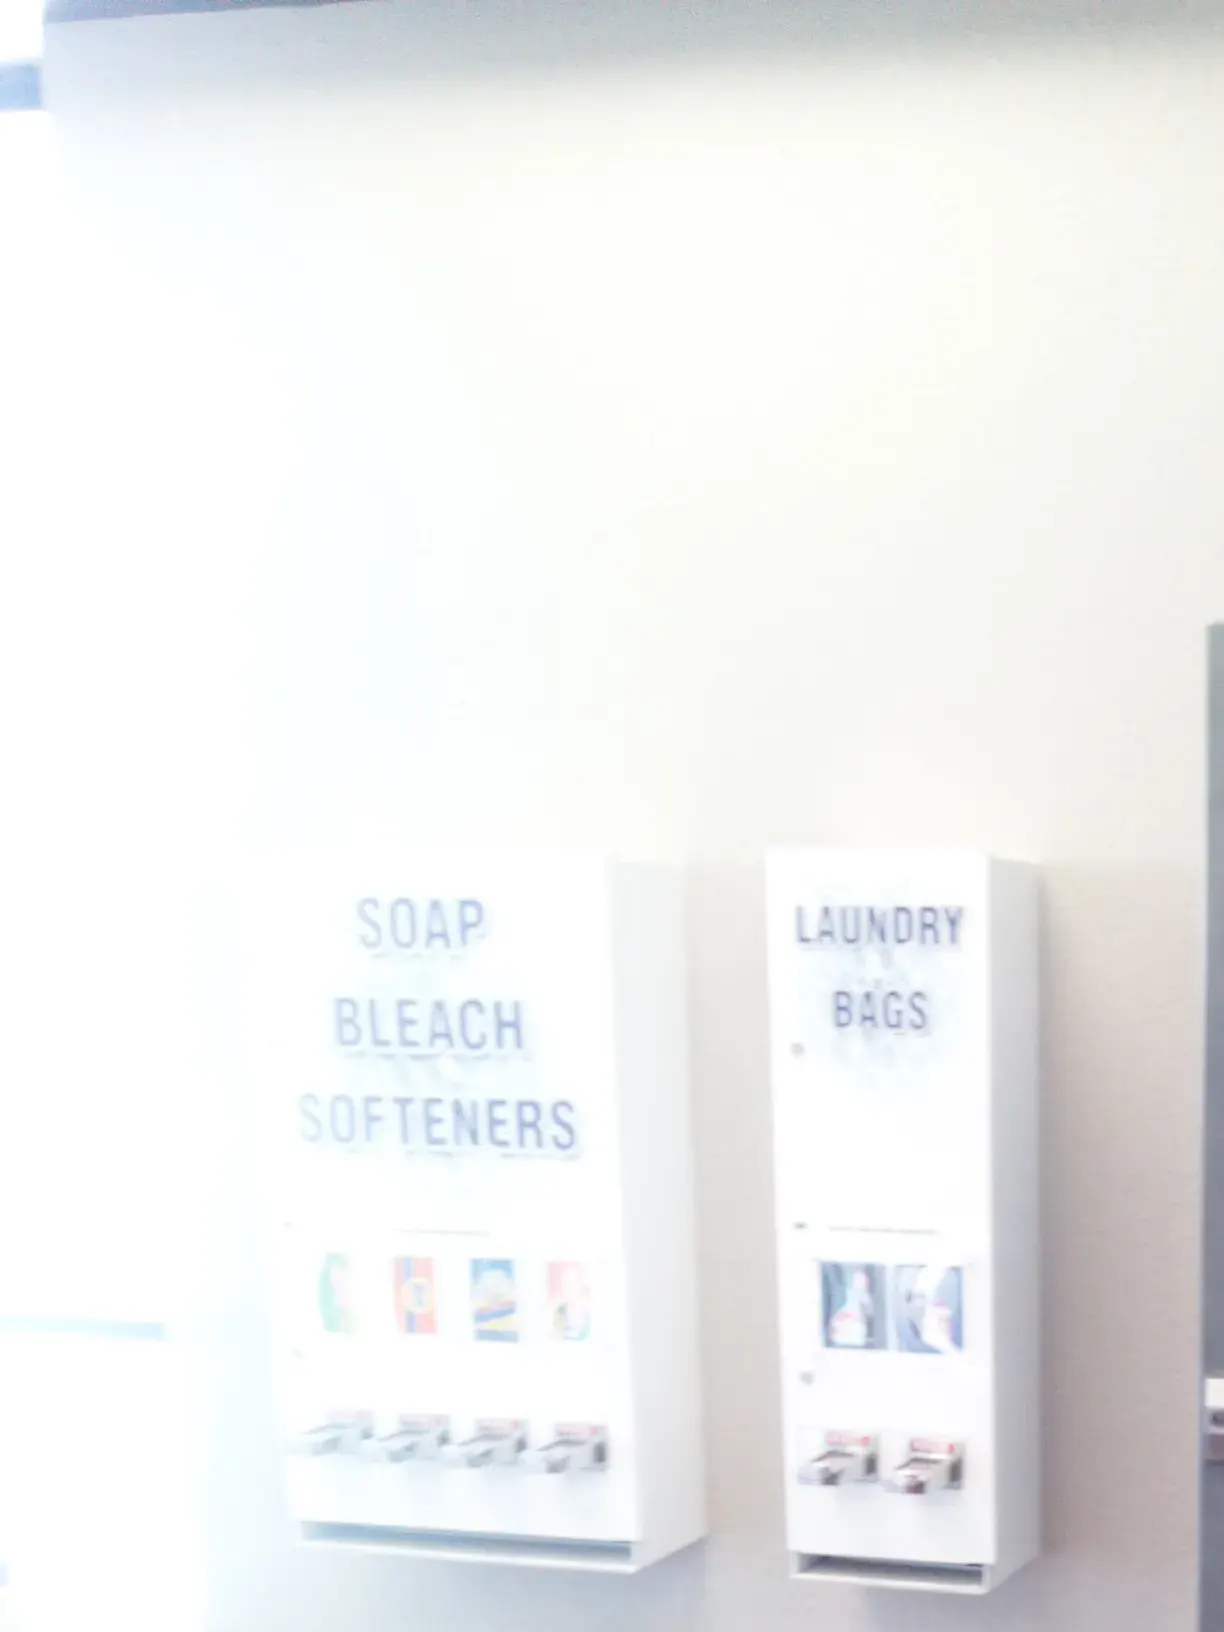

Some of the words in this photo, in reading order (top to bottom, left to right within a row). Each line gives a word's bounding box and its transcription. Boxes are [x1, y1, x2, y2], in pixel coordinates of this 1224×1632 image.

[355, 896, 485, 951] SOAP
[796, 905, 964, 946] LAUNDRY
[333, 996, 525, 1051] BLEACH
[833, 989, 929, 1031] BAGS
[299, 1092, 578, 1151] SOFTENERS
